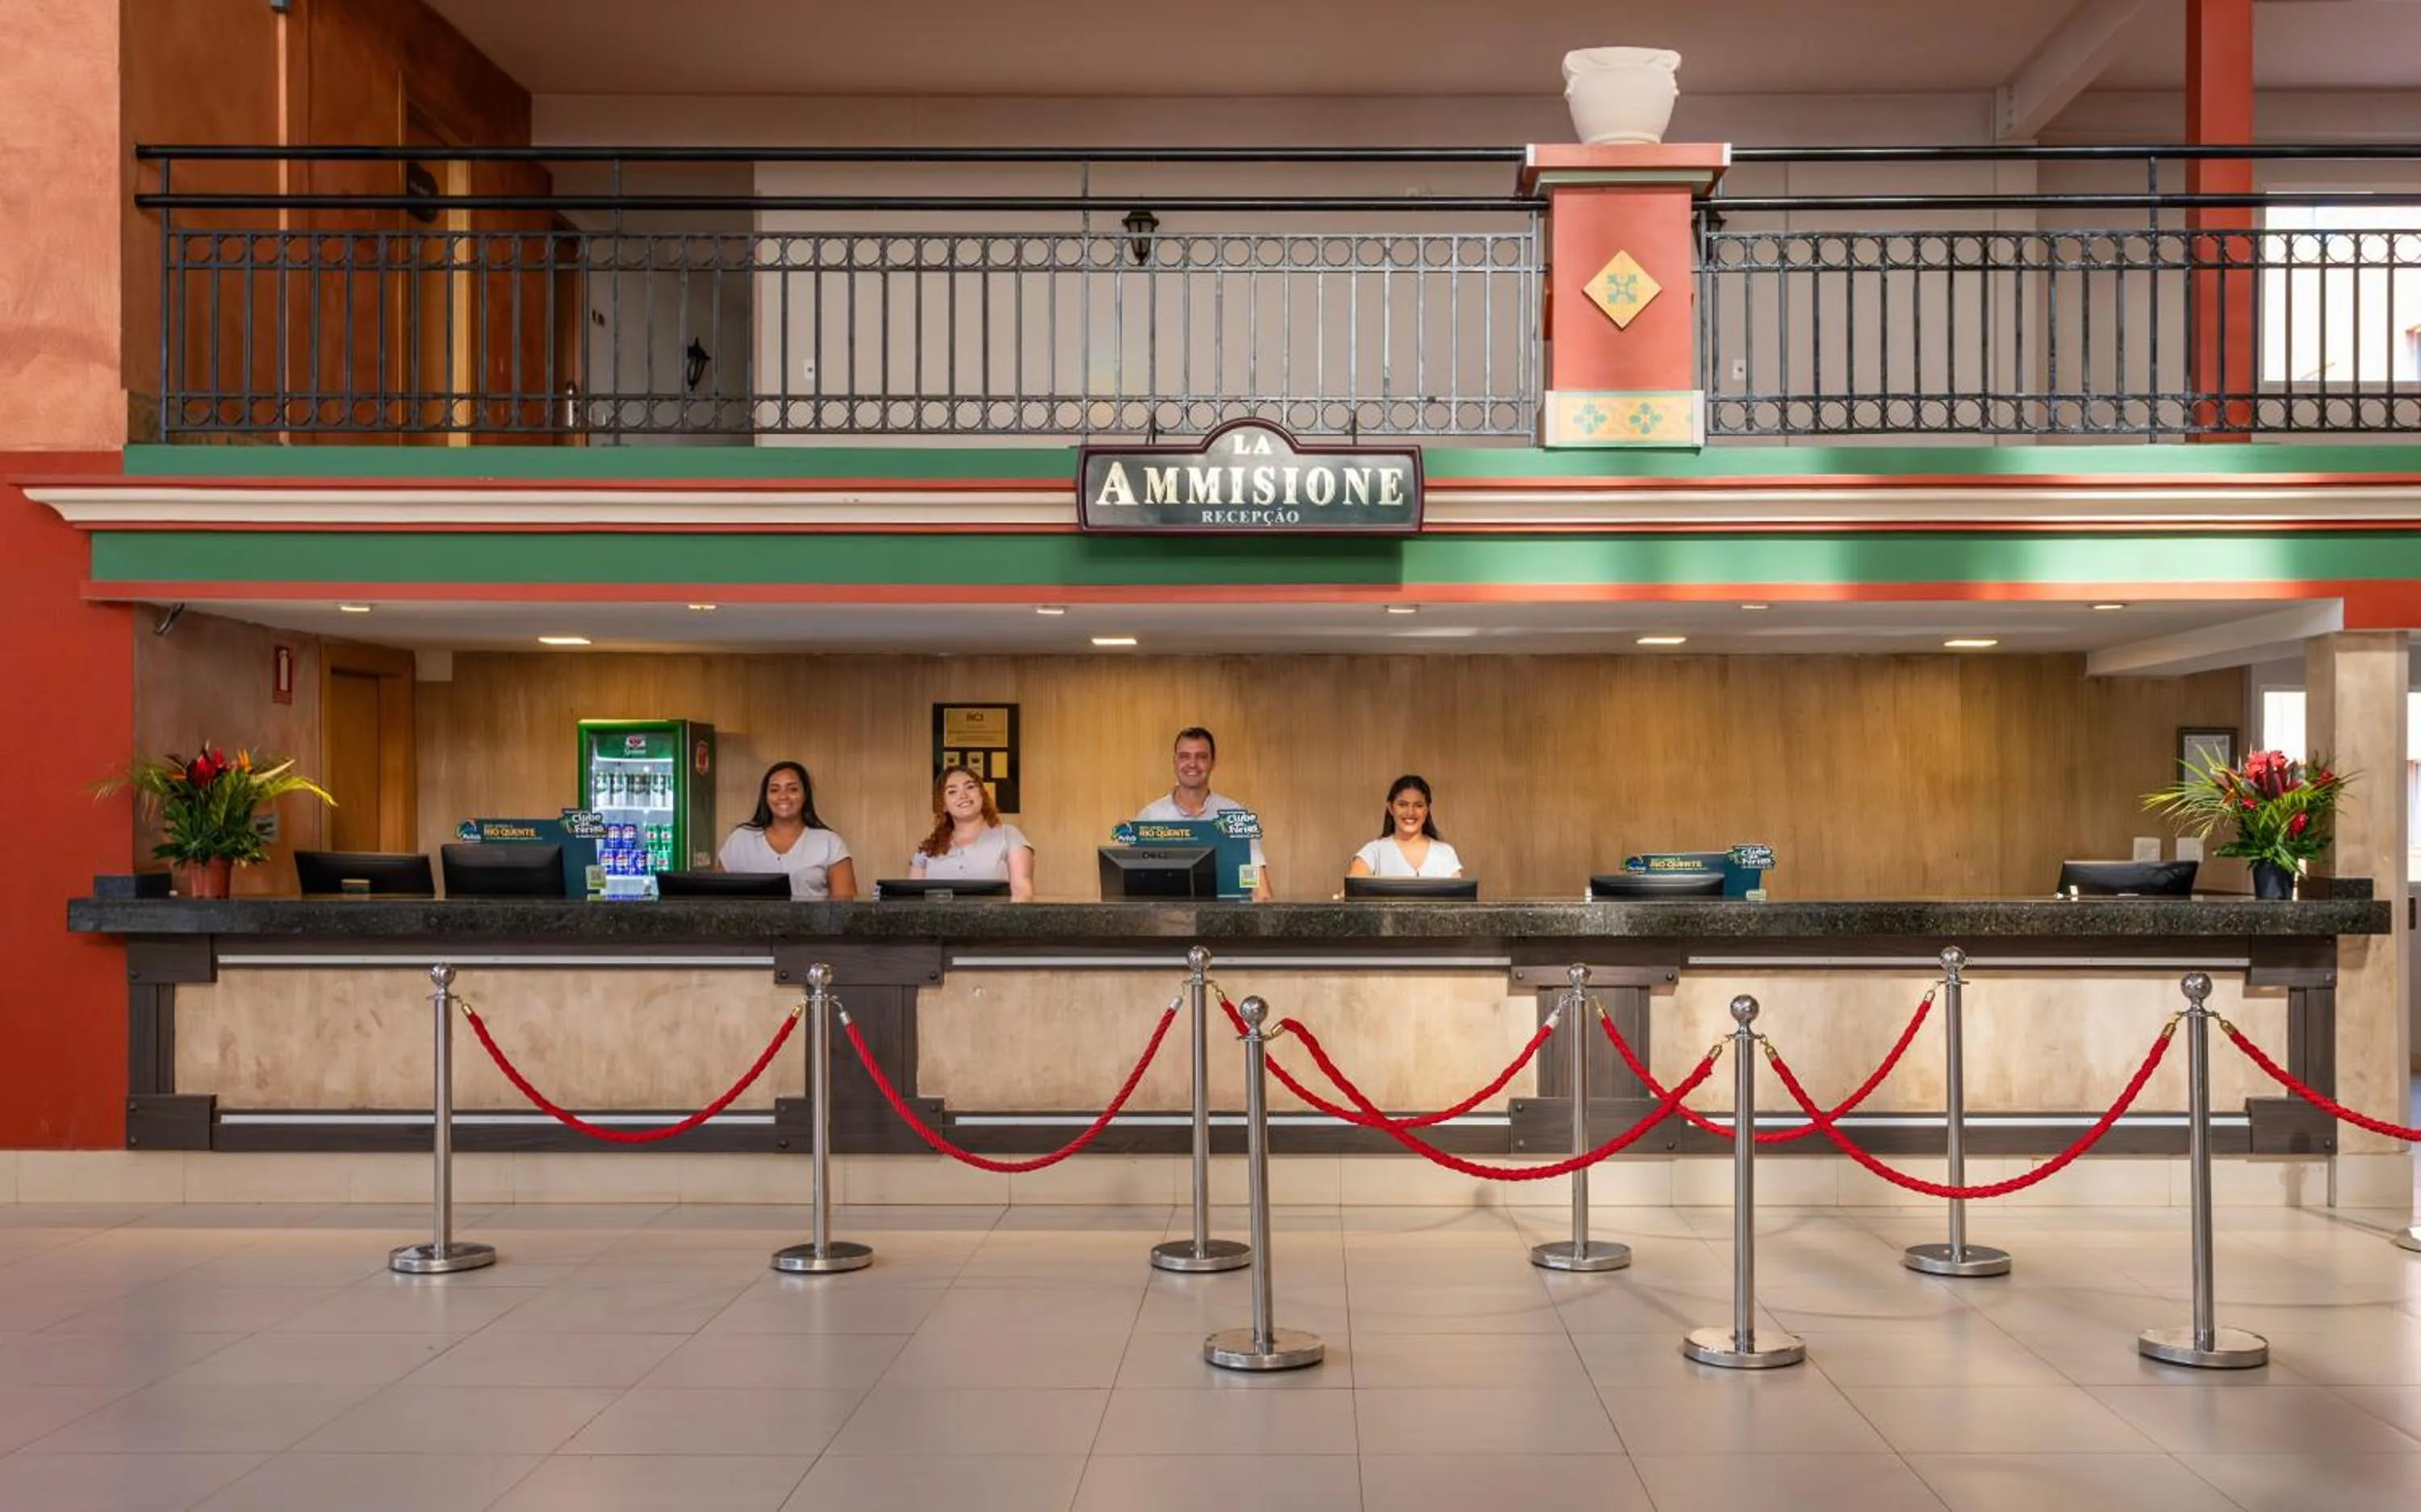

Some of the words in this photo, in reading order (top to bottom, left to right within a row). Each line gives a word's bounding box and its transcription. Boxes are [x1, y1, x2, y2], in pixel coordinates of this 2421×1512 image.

[1233, 434, 1272, 455] LA
[1095, 461, 1404, 507] AMMISIONE
[1201, 508, 1300, 527] RECEPÇÃO
